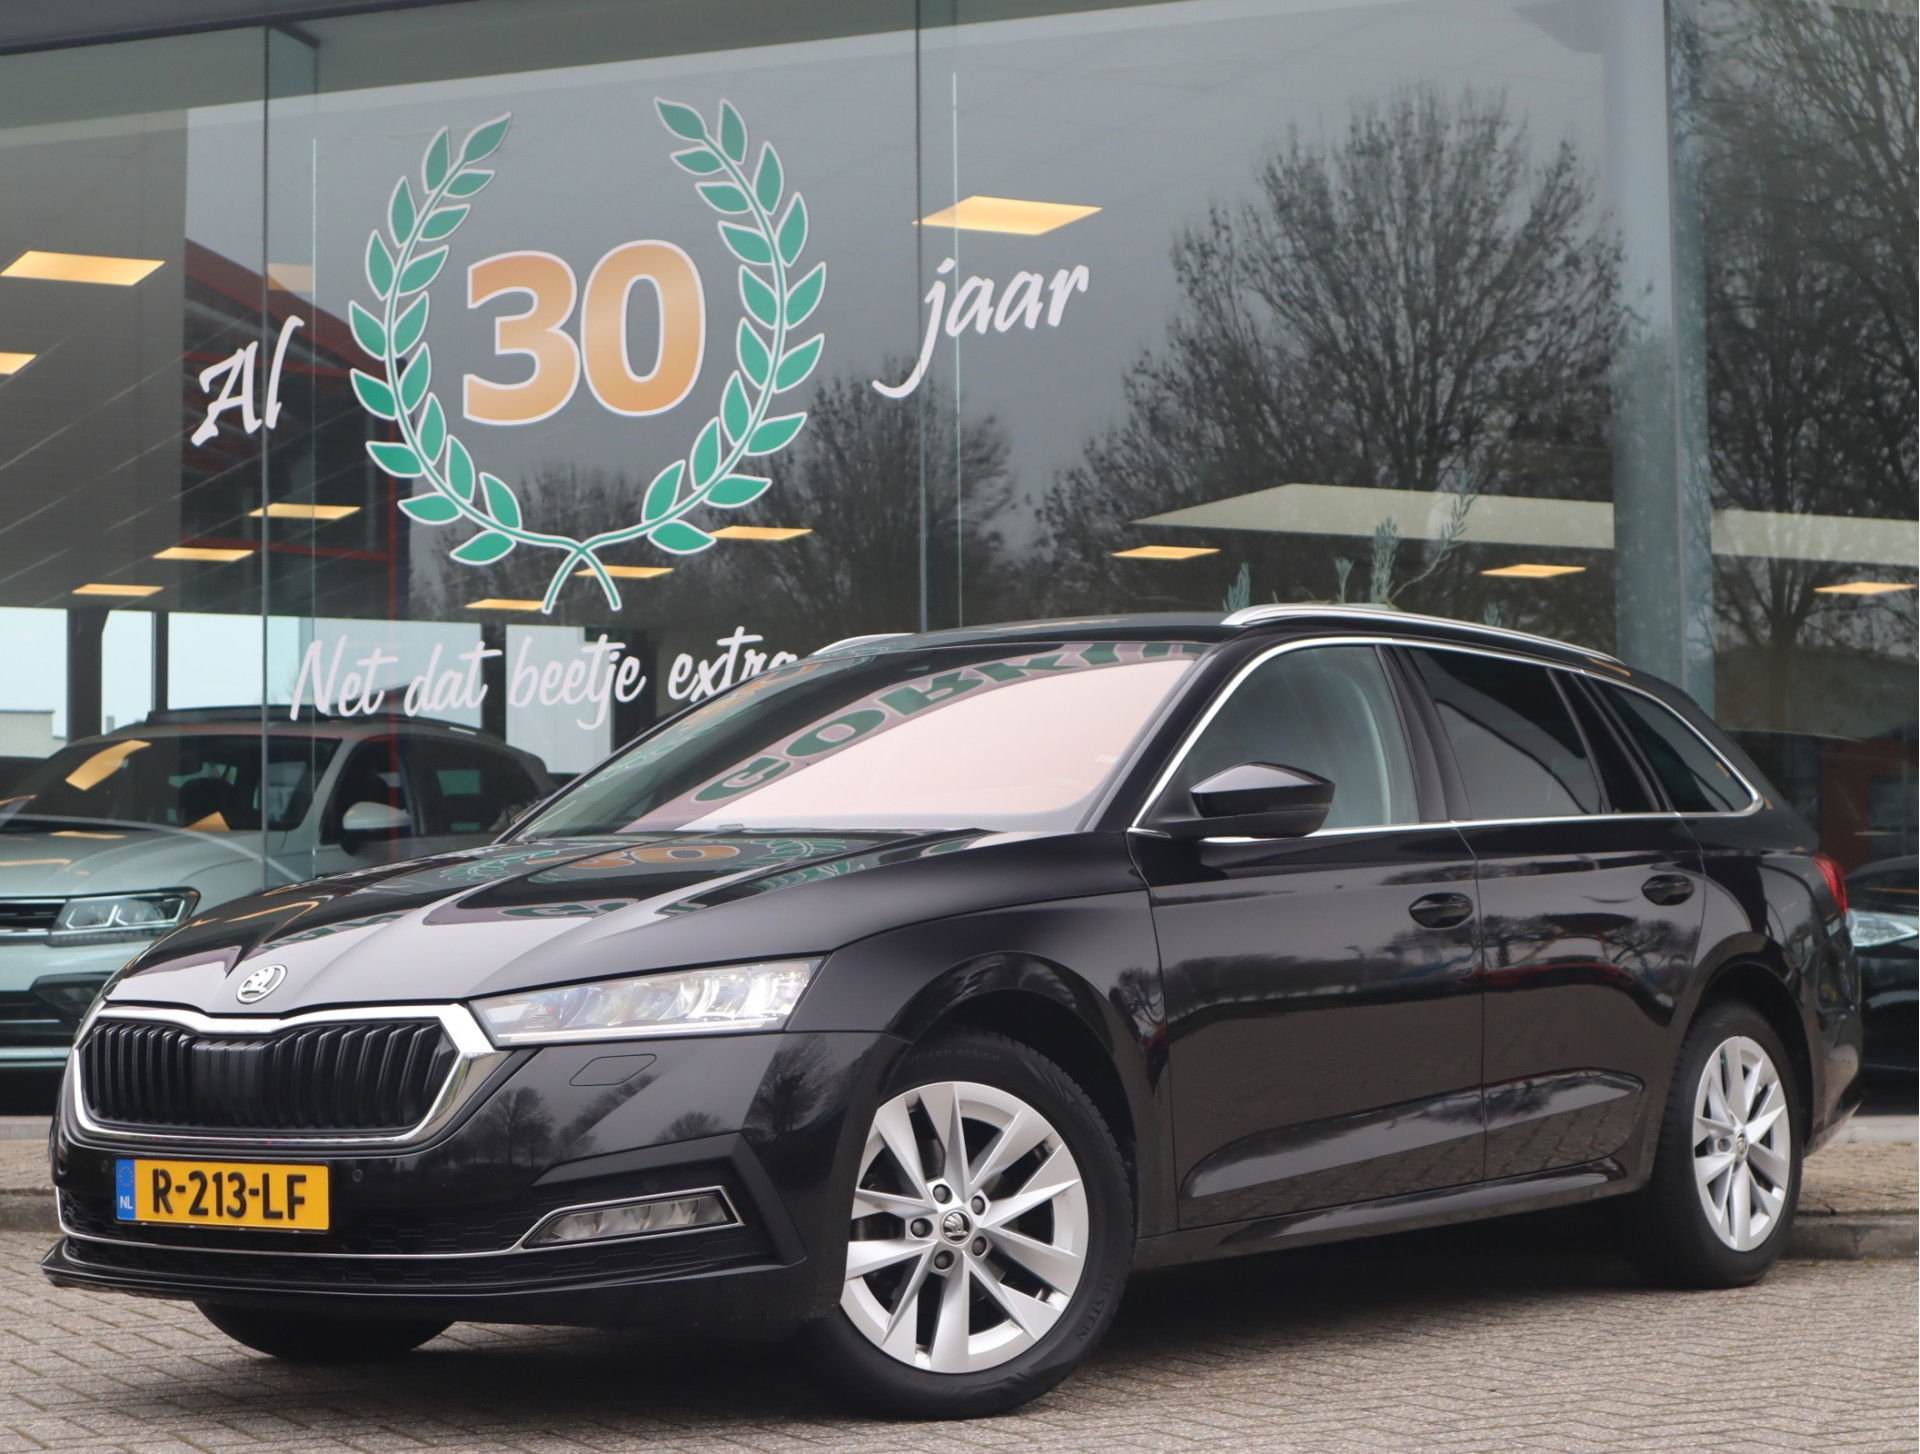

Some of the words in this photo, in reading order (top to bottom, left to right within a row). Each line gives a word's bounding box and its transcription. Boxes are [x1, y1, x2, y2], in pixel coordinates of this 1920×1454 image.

[191, 315, 305, 447] Al
[463, 239, 706, 426] 30
[872, 257, 1089, 399] jaar
[290, 634, 398, 721] Net
[403, 640, 503, 717] dat
[508, 633, 647, 731] beetje
[119, 1195, 133, 1210] NL
[152, 1168, 307, 1220] R-213-LF
